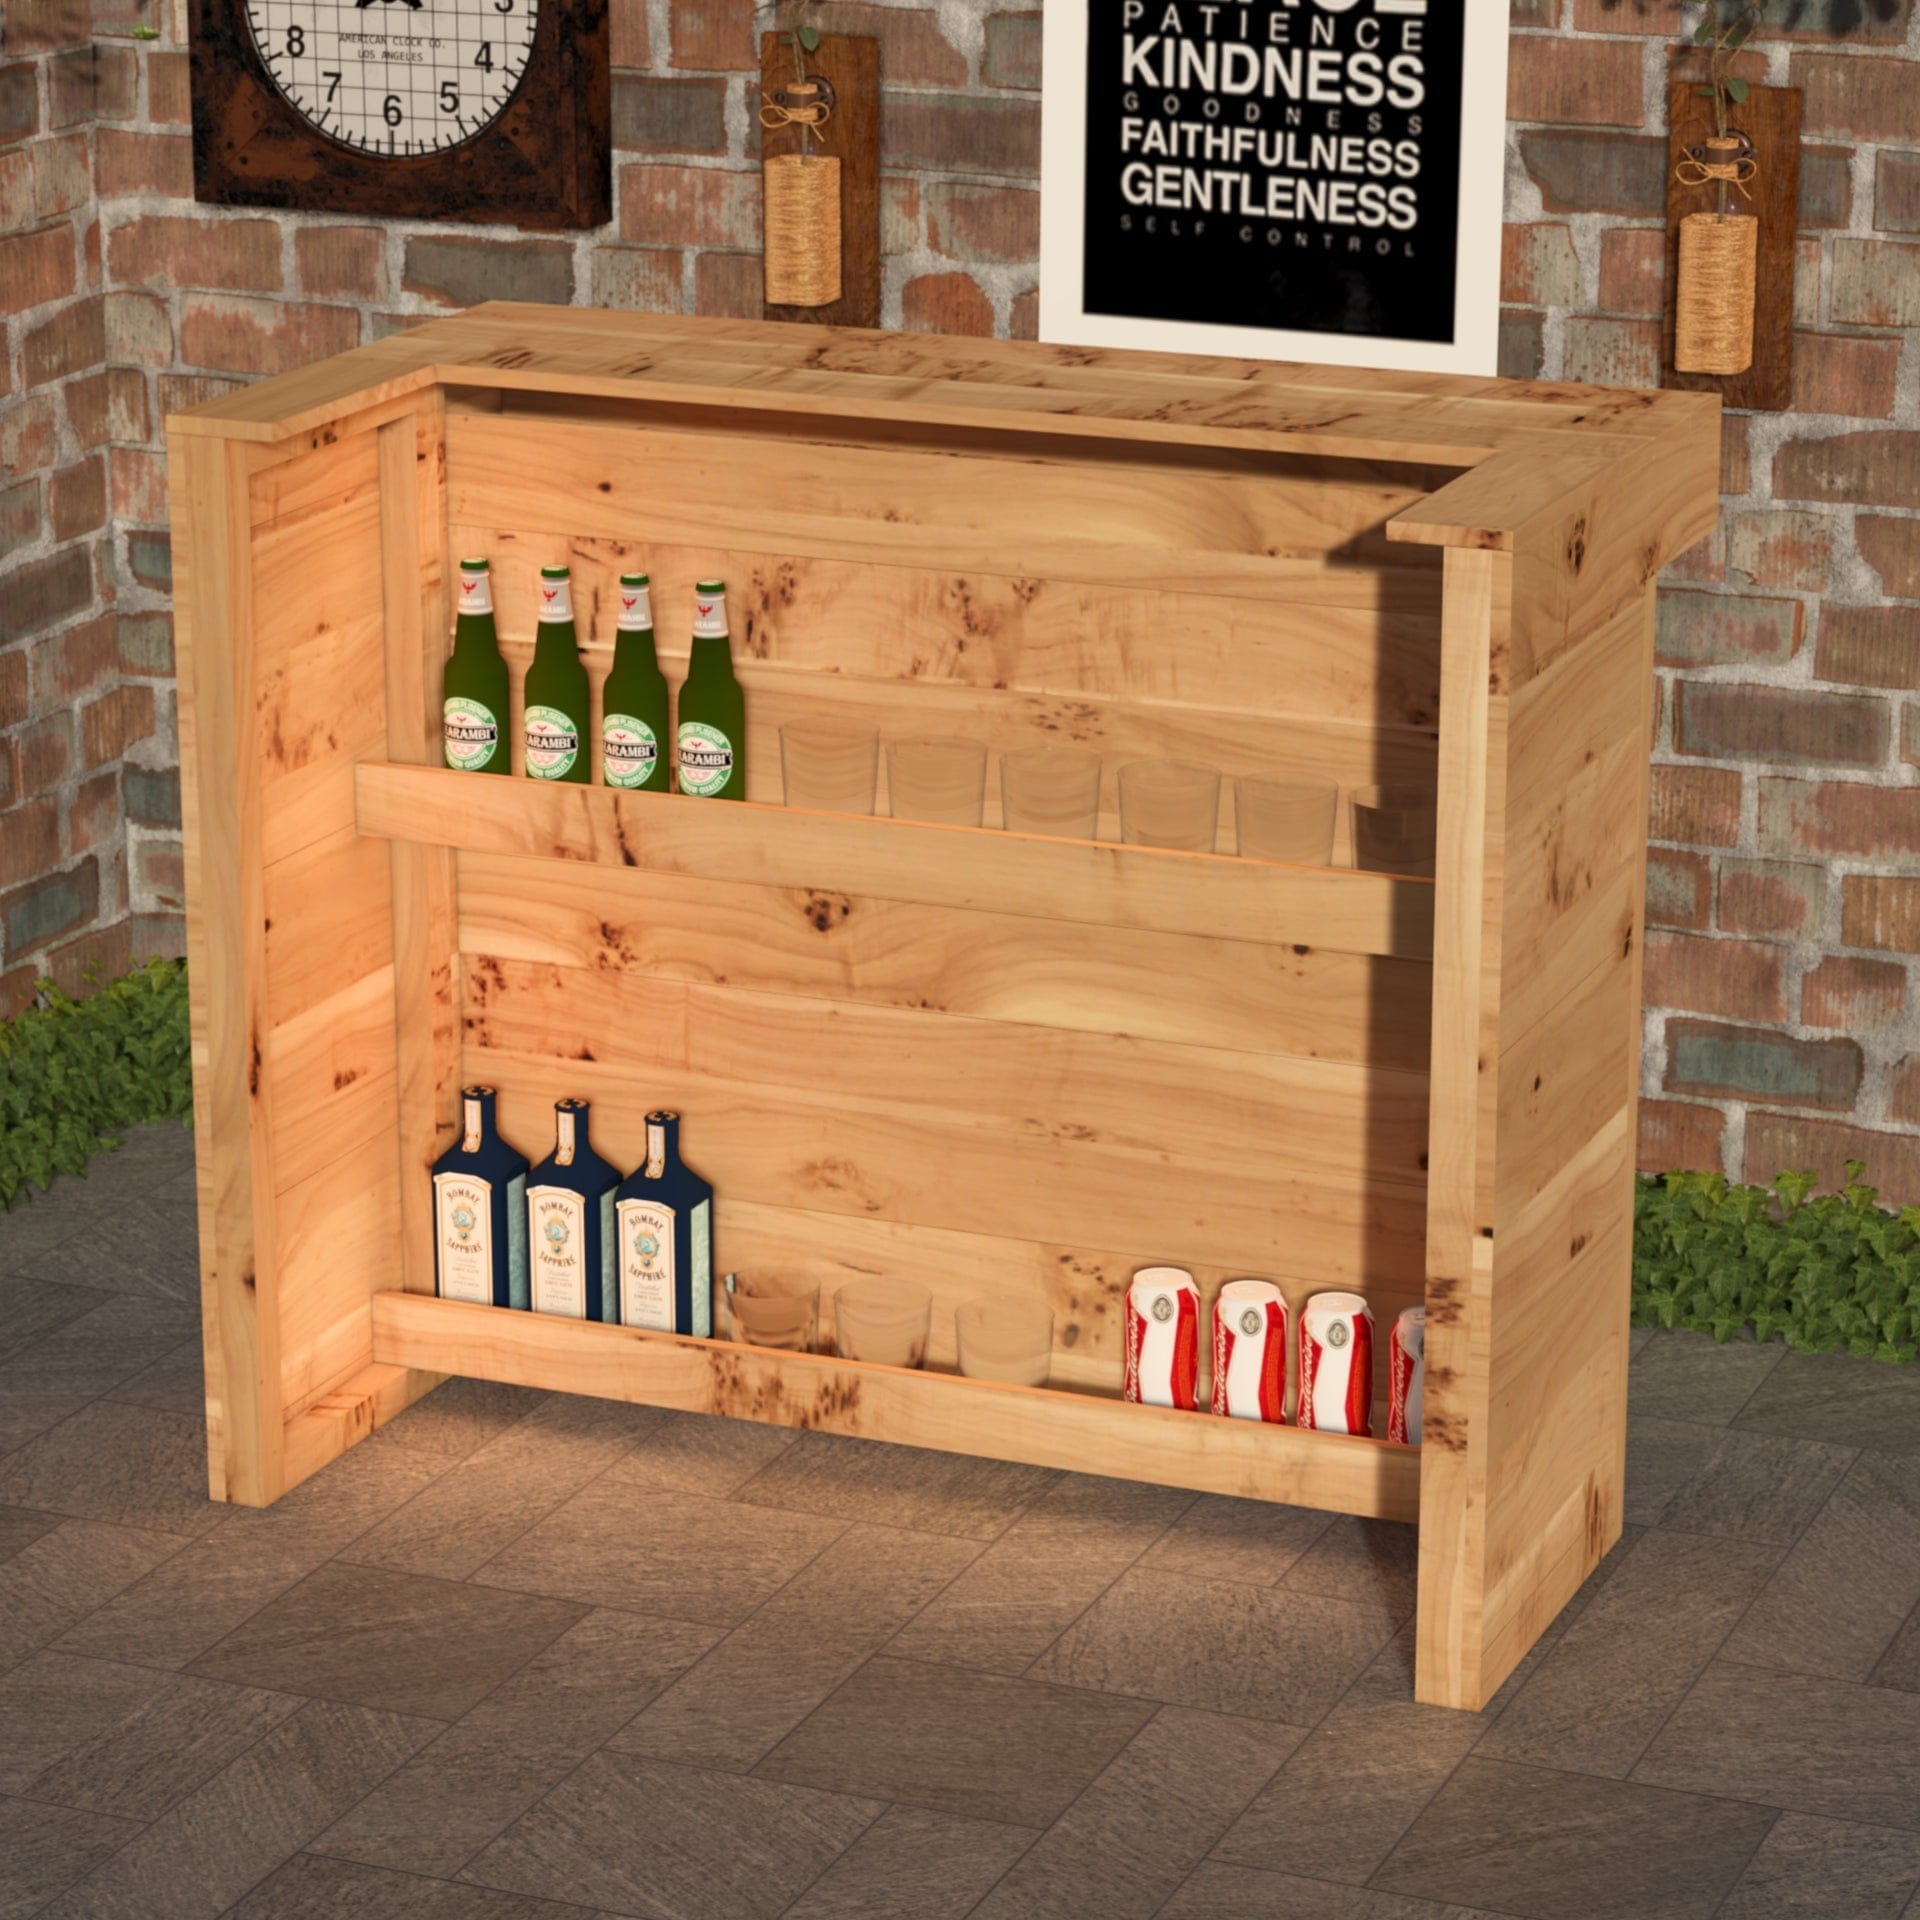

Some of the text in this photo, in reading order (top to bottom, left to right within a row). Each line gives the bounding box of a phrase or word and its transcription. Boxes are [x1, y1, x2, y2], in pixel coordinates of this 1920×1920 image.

[286, 25, 305, 58] 8
[338, 32, 387, 45] AMERICAN
[392, 35, 423, 47] CLOCK
[1122, 0, 1424, 51] PATIENCE
[357, 49, 424, 62] LOS ANGELES
[474, 41, 494, 73] 4
[1122, 33, 1425, 109] KINDNESS
[322, 71, 342, 103] 7
[439, 81, 459, 113] 5
[383, 94, 402, 127] 6
[1123, 91, 1423, 136] GOODNESS
[1121, 116, 1421, 178] FAITHFULNESS
[1120, 161, 1418, 230] GENTLENESS
[1120, 214, 1415, 258] SELF CONTROL
[446, 1188, 480, 1206] BOMBAY
[539, 1201, 574, 1219] BOMBAY
[629, 1214, 664, 1233] BOMBAY
[446, 1237, 483, 1254] SAPPHIRE
[539, 1250, 577, 1268] SAPPHIRE
[628, 1263, 667, 1281] SAPPHIRE
